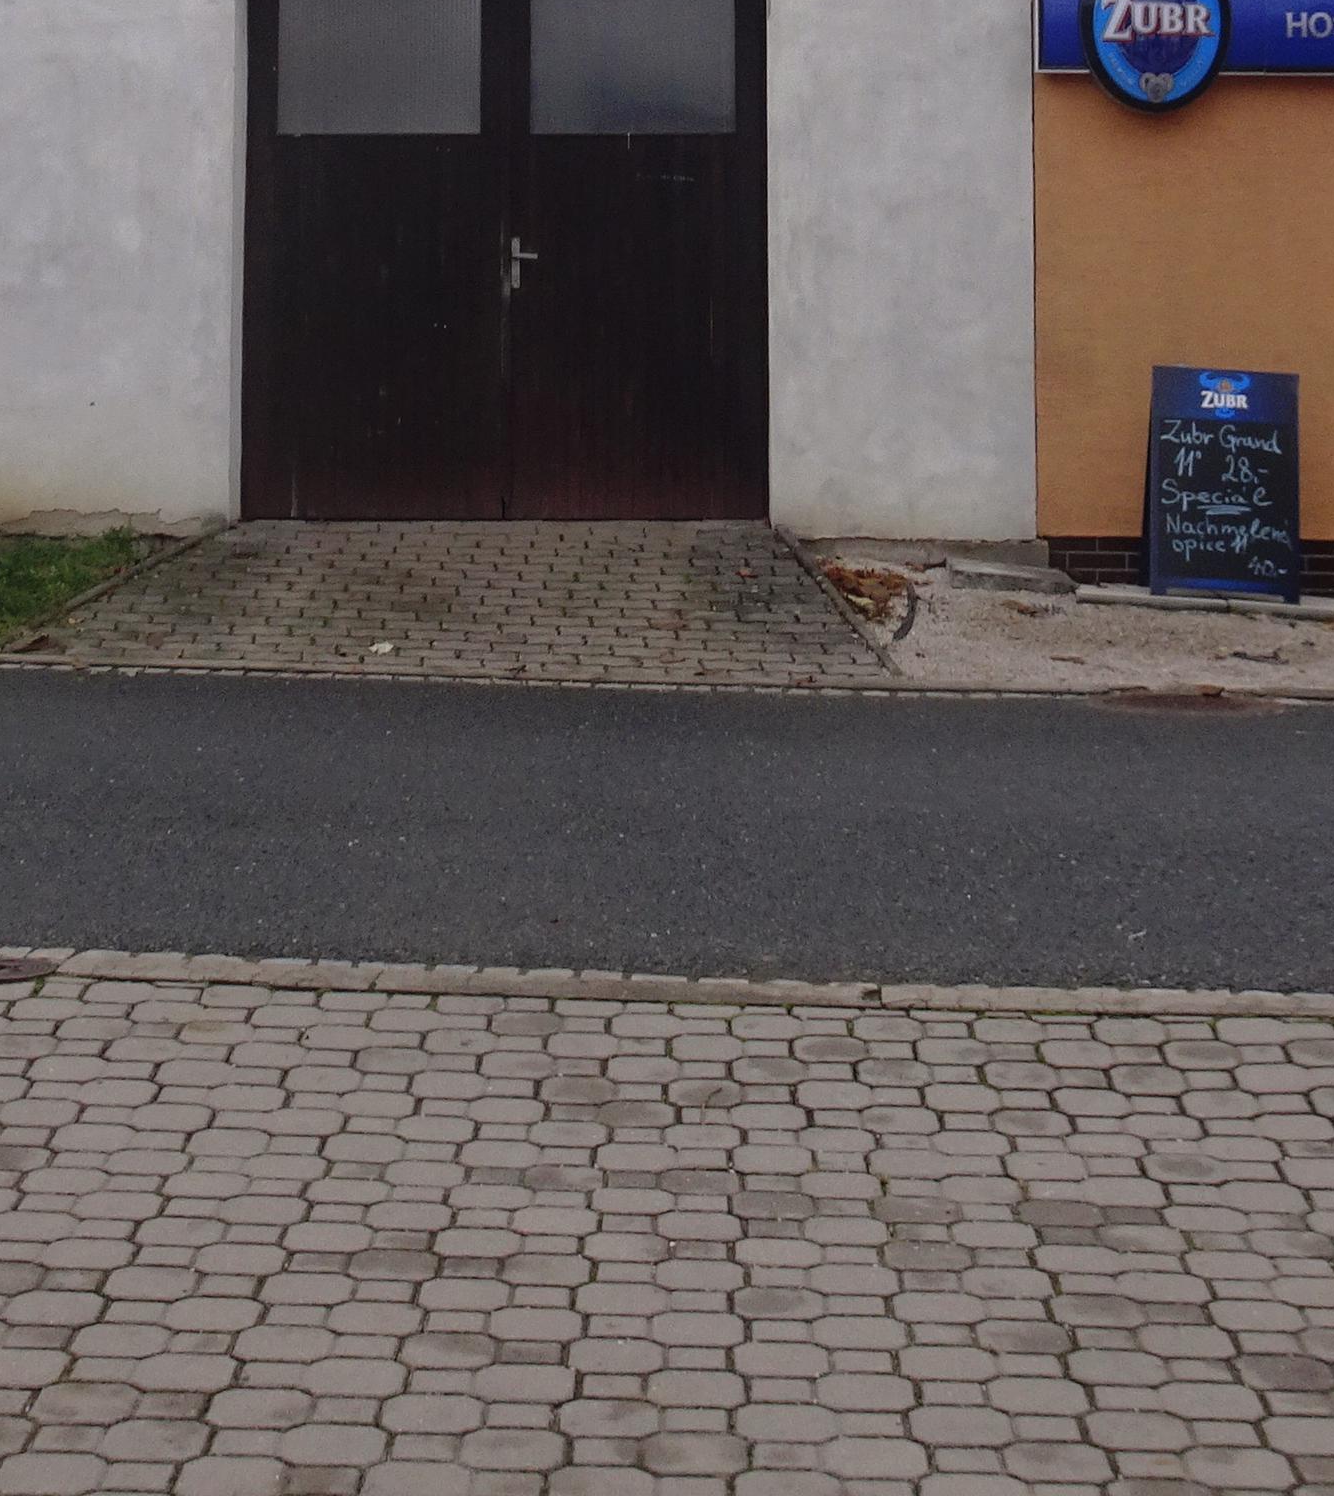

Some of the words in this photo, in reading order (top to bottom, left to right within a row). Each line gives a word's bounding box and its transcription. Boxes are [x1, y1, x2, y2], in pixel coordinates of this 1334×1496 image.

[1200, 390, 1249, 409] ZUBR
[1161, 419, 1214, 444] Zubr
[1172, 539, 1226, 562] opice
